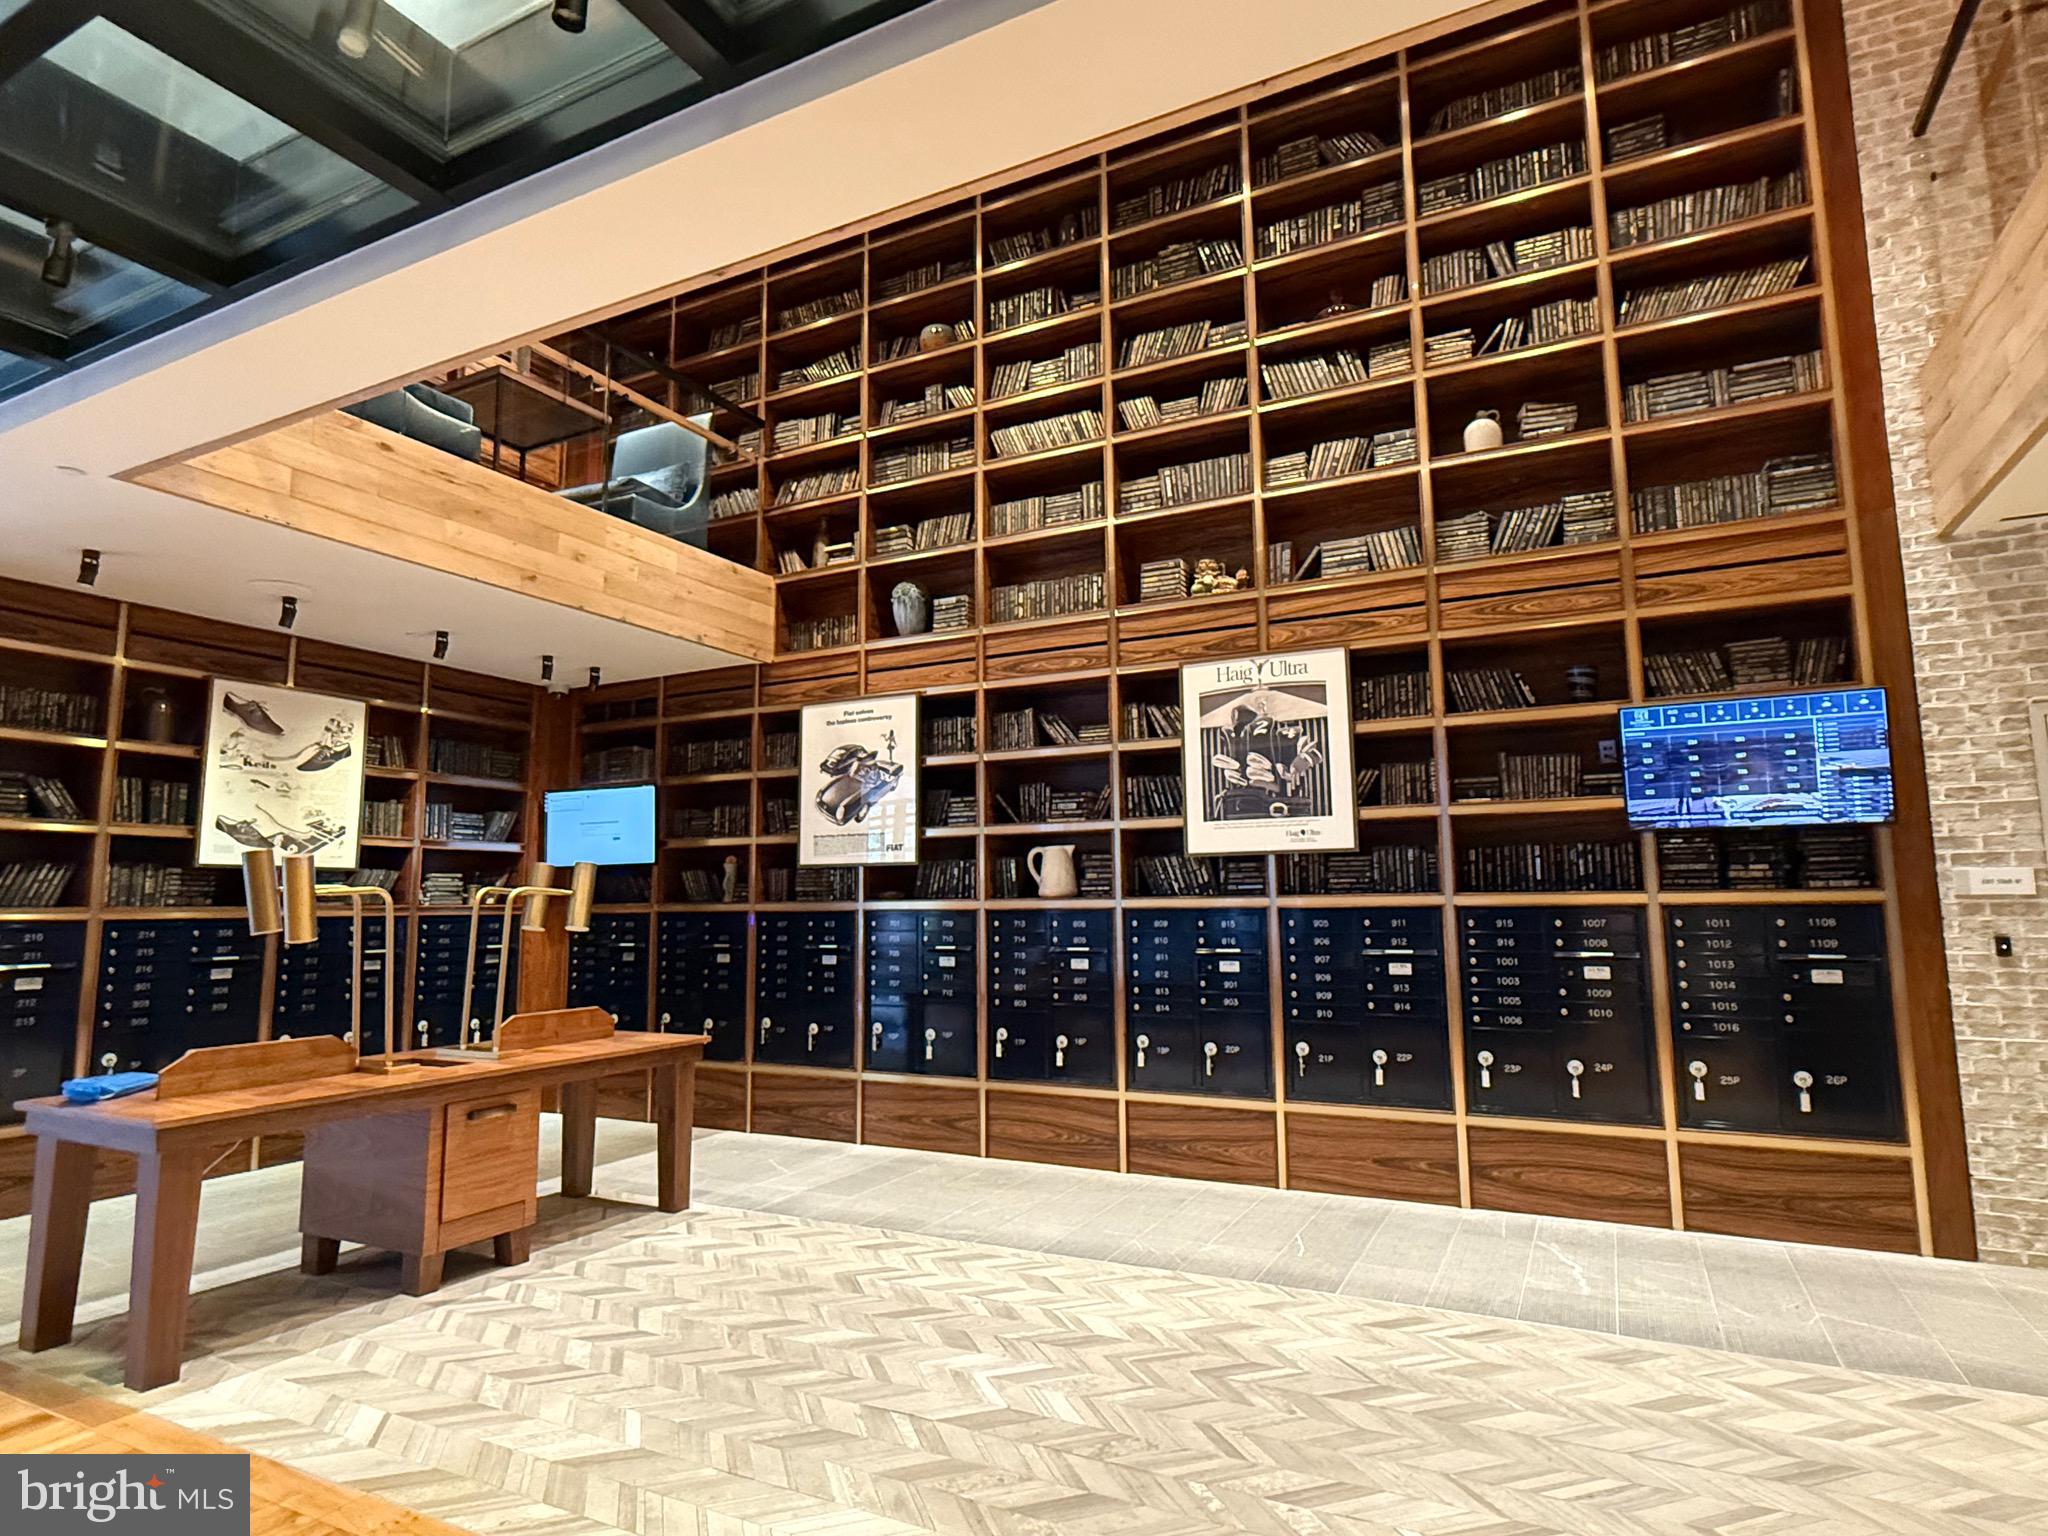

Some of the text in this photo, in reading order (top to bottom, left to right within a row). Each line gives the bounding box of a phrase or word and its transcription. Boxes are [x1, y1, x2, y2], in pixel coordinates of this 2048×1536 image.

[1216, 660, 1309, 684] Haig Ultra
[886, 843, 904, 853] FIAT
[1013, 920, 1026, 928] 713
[1312, 920, 1330, 928] 905
[1391, 919, 1406, 928] 911
[1495, 919, 1514, 928] 915
[1582, 919, 1607, 928] 1007
[1705, 919, 1730, 928] 1011
[1807, 918, 1837, 928] 1108
[1013, 935, 1026, 943] 714
[1313, 938, 1330, 946] 906
[1390, 938, 1408, 946] 912
[1496, 938, 1516, 947] 916
[1583, 939, 1609, 948] 1008
[1706, 940, 1732, 949] 1012
[1809, 939, 1839, 949] 1109
[1314, 956, 1331, 964] 907
[1496, 957, 1519, 966] 1001
[1708, 960, 1735, 970] 1013
[1013, 968, 1027, 976] 716
[1154, 971, 1169, 979] 812
[1314, 974, 1332, 982] 908
[1496, 977, 1521, 986] 1003
[1223, 981, 1238, 989] 901
[1392, 984, 1410, 993] 913
[1709, 981, 1737, 990] 1014
[1154, 988, 1170, 996] 813
[1315, 992, 1333, 1000] 909
[1586, 989, 1613, 998] 1009
[1223, 998, 1239, 1007] 903
[1498, 997, 1522, 1006] 1005
[1155, 1005, 1170, 1013] 814
[1394, 1003, 1411, 1011] 914
[1711, 1002, 1739, 1012] 1015
[1316, 1010, 1333, 1019] 910
[1588, 1009, 1614, 1018] 1010
[1498, 1016, 1523, 1026] 1006
[1713, 1023, 1741, 1033] 1016
